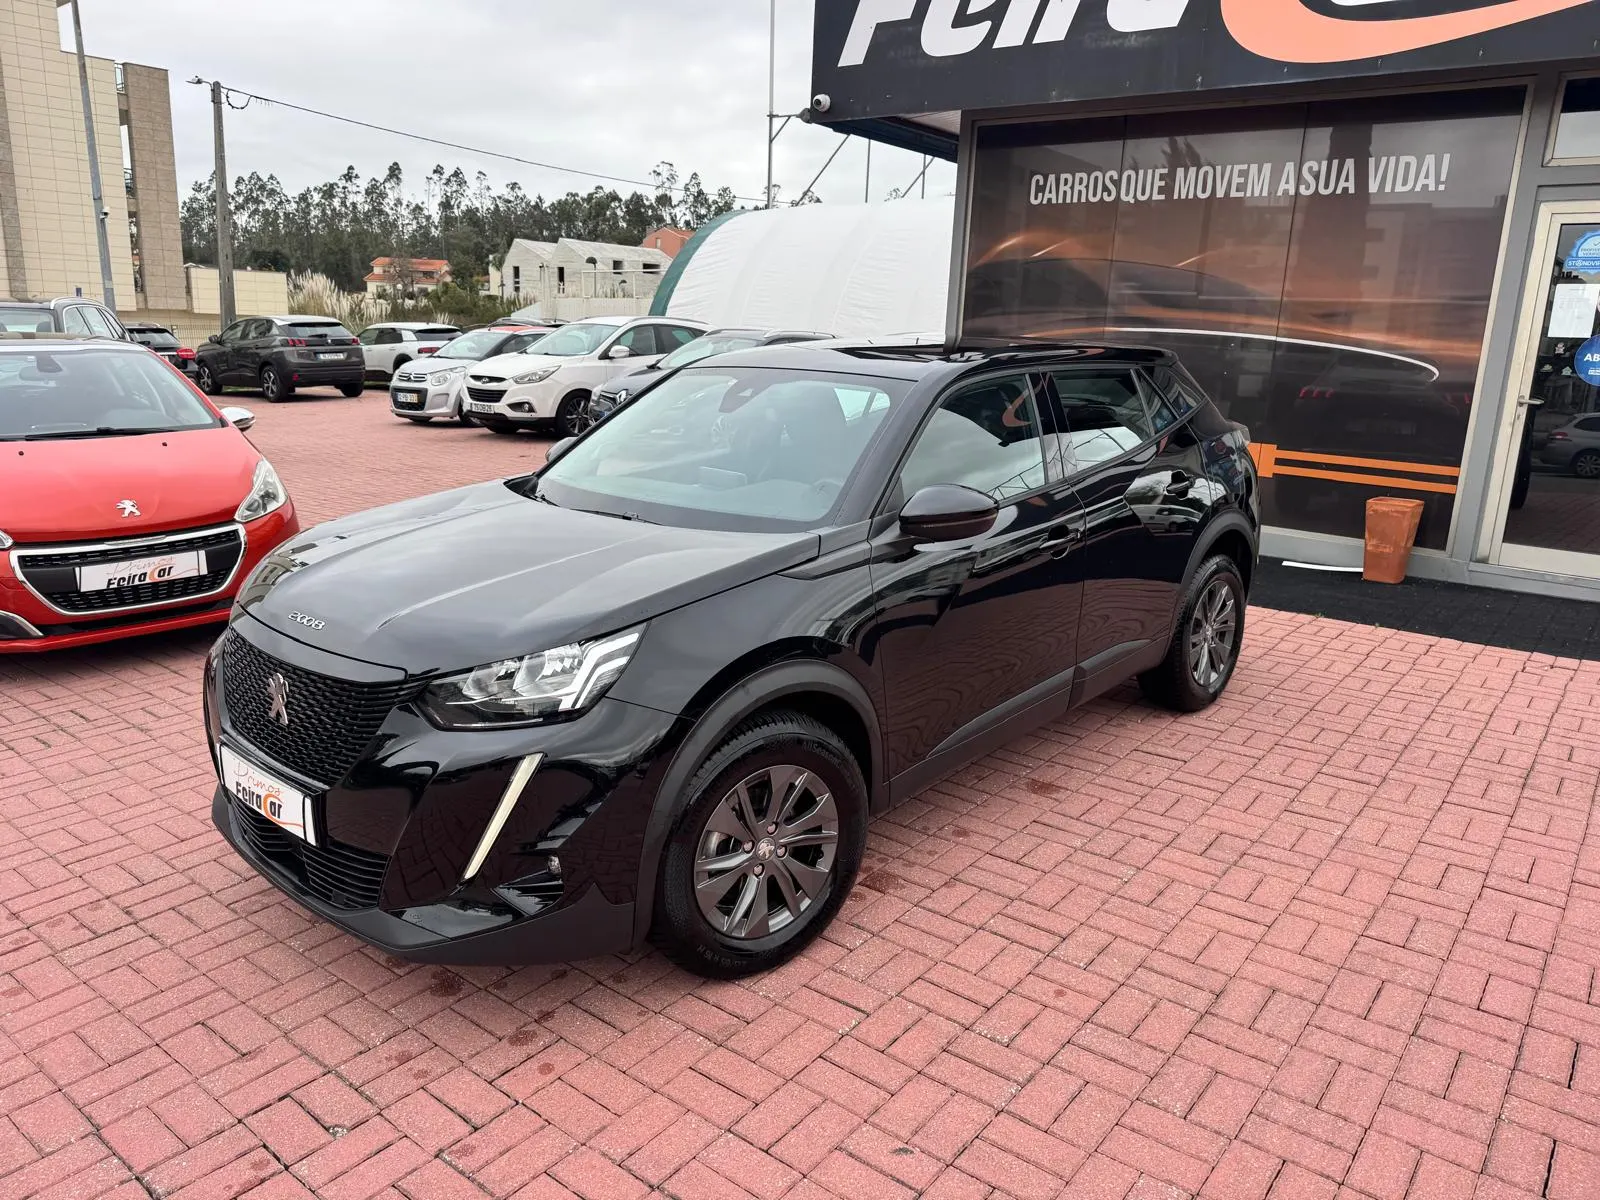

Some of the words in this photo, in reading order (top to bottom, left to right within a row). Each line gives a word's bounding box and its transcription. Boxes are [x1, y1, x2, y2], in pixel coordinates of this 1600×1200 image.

[1029, 169, 1118, 205] CARROS
[1120, 168, 1168, 204] QUE
[1173, 163, 1272, 200] MOVEM
[1276, 162, 1295, 197] A
[1299, 158, 1355, 196] SUA
[1368, 153, 1450, 193] VIDA!
[288, 610, 326, 631] 2008
[236, 781, 283, 823] FeiraCar
